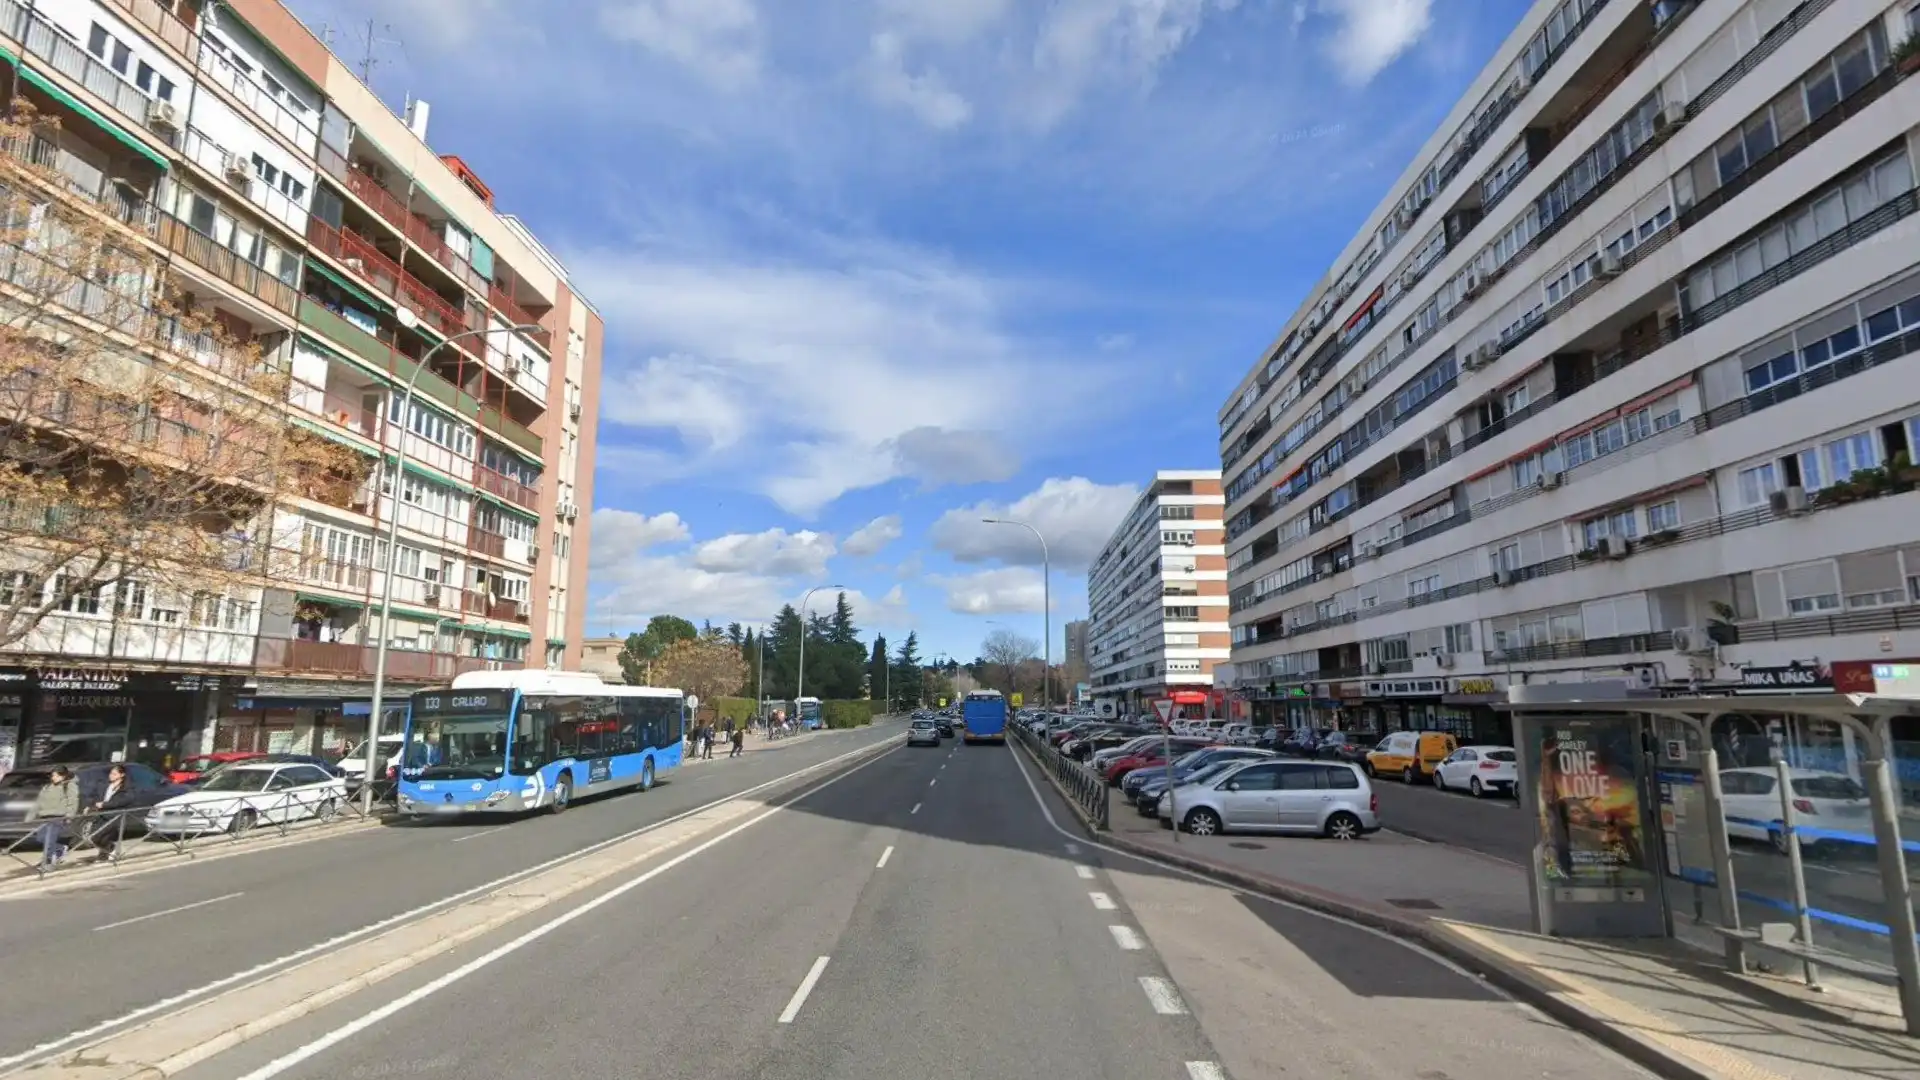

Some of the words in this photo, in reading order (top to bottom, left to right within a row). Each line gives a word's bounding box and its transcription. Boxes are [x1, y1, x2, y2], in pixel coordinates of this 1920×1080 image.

[1743, 671, 1776, 686] MIKA
[1779, 667, 1816, 685] UÑAS
[425, 696, 440, 710] 133
[451, 695, 488, 708] CALLAO
[1559, 750, 1598, 775] ONE
[1562, 775, 1610, 798] LOVE
